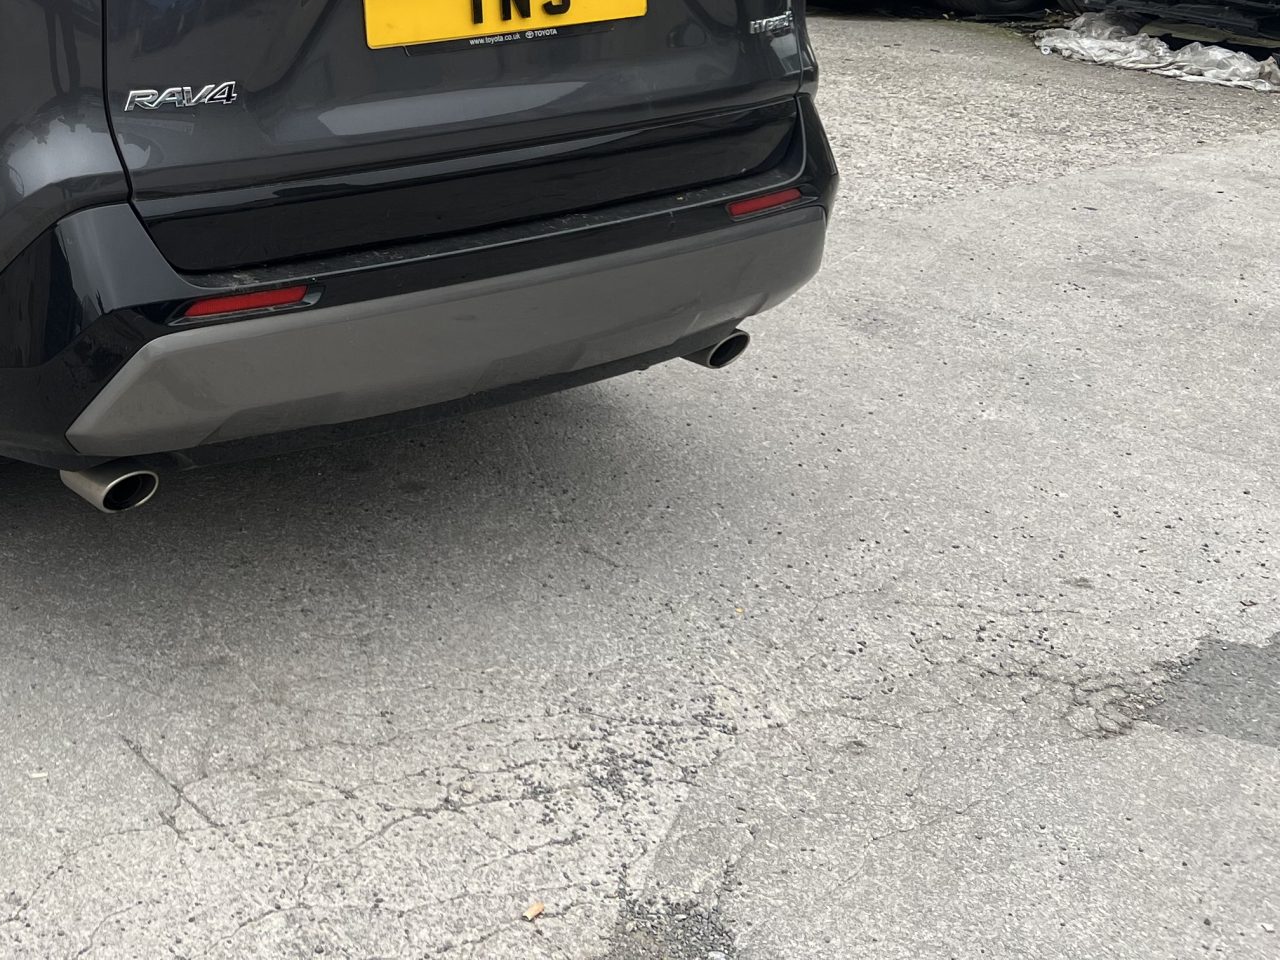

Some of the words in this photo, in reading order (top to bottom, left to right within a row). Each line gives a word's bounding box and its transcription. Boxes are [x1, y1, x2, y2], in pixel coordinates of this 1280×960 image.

[469, 33, 521, 46] www.toyota.co.uk
[534, 28, 558, 38] TOYOTA
[124, 80, 238, 111] RAV4
